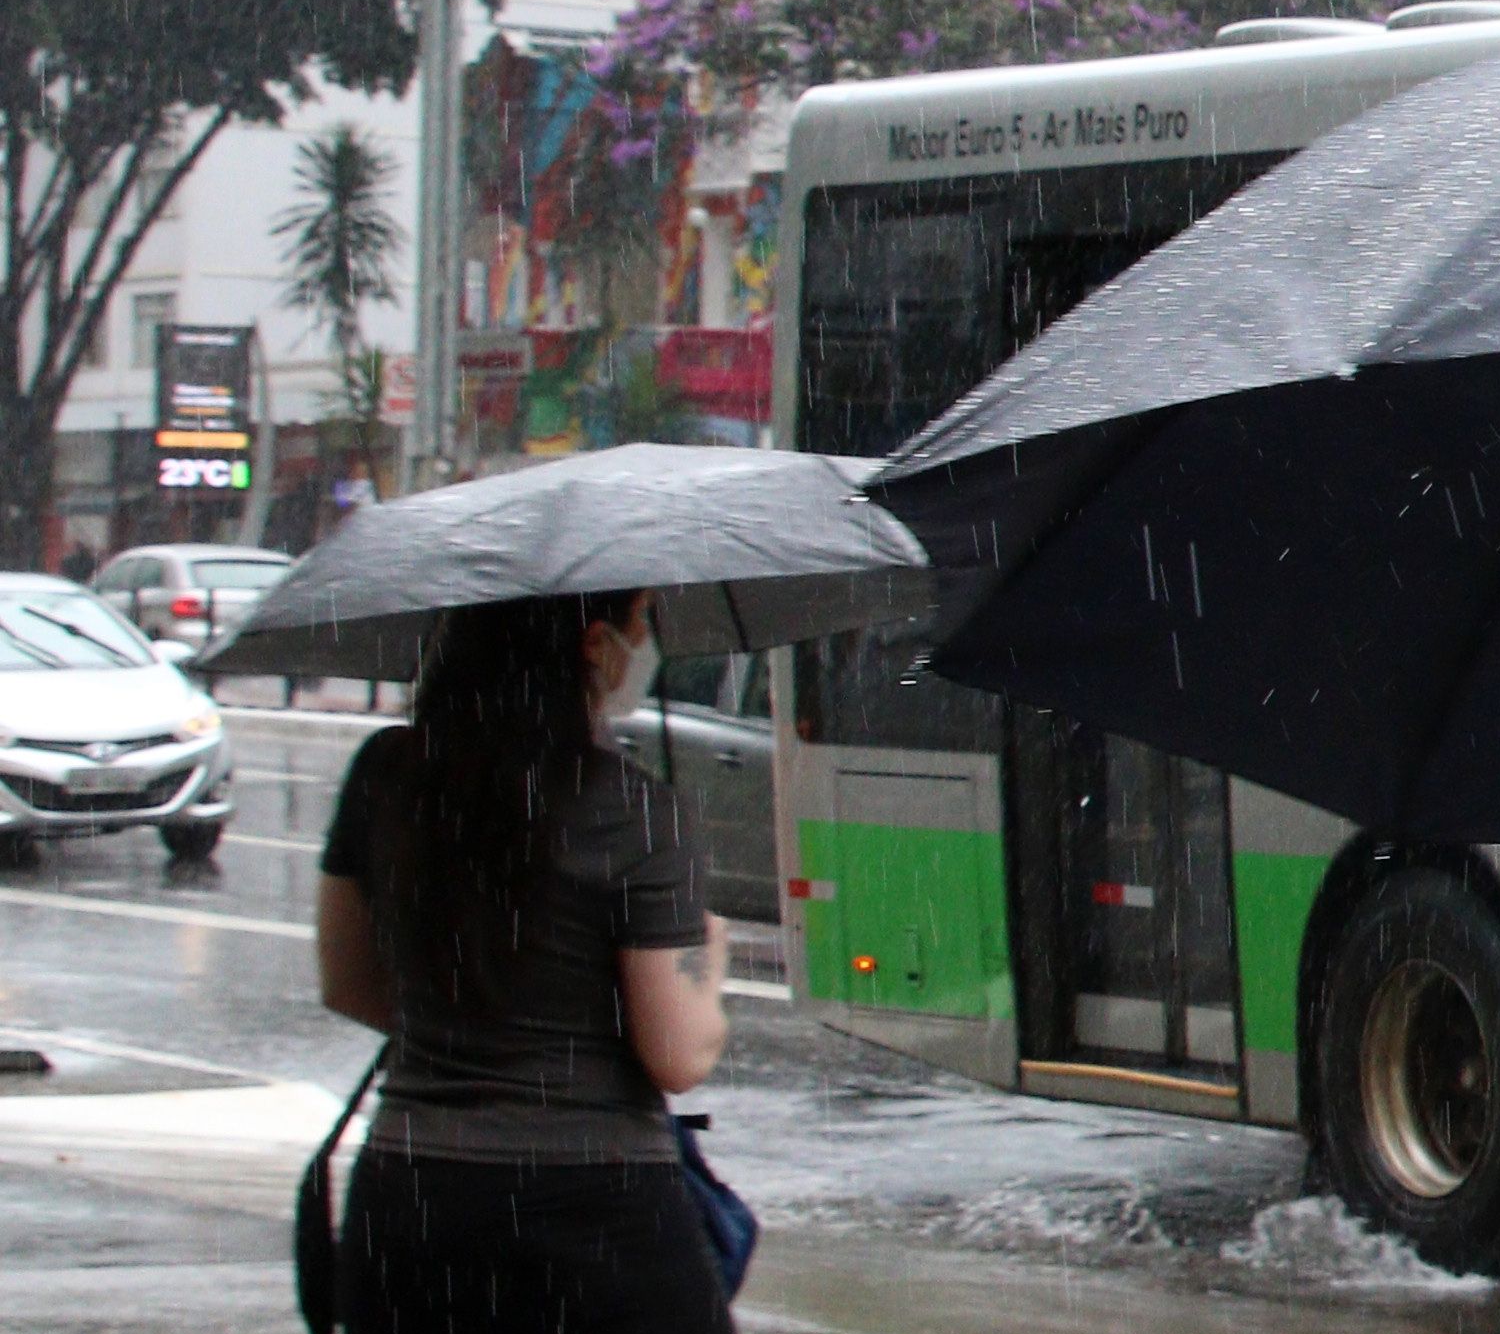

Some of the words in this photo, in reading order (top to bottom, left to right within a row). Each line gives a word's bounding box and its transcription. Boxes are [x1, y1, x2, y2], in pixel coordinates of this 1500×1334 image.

[889, 124, 948, 161] Motor
[954, 118, 1003, 158] Euro
[1012, 113, 1024, 152] 5
[1042, 111, 1068, 149] Ar
[1074, 106, 1126, 146] Mais
[1134, 103, 1188, 142] Puro
